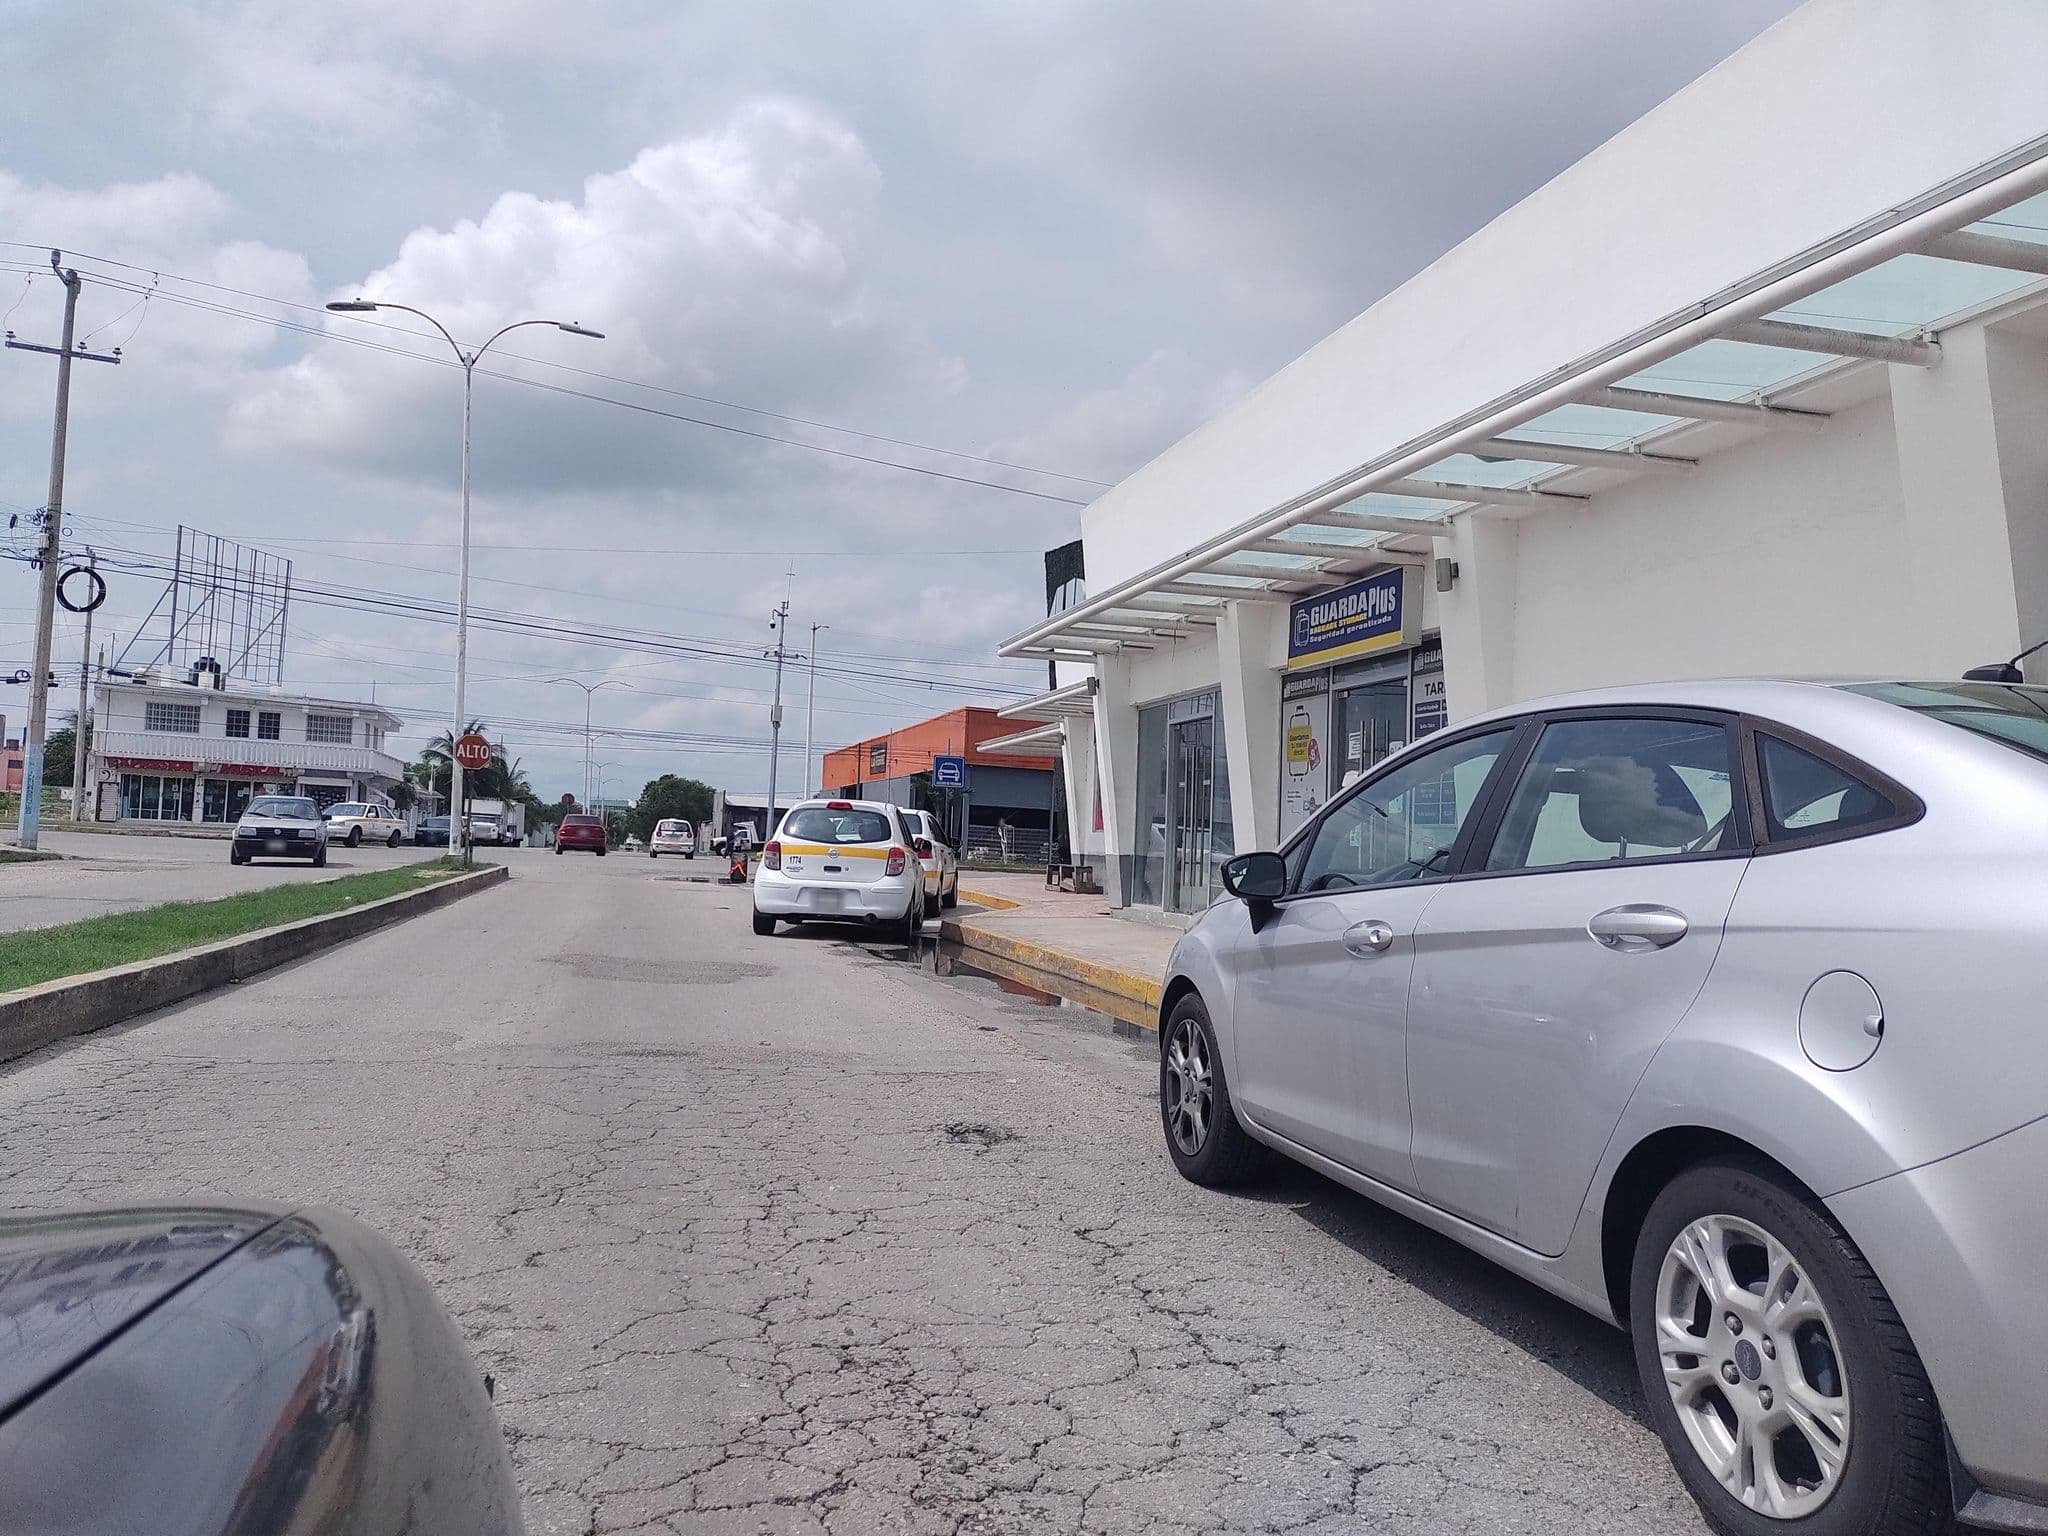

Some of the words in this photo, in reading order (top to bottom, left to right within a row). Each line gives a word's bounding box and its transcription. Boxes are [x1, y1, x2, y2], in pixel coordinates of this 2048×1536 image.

[1309, 627, 1345, 643] Seguridad
[1346, 615, 1392, 634] garantizada
[456, 744, 490, 760] ALTO
[789, 855, 802, 865] 1774
